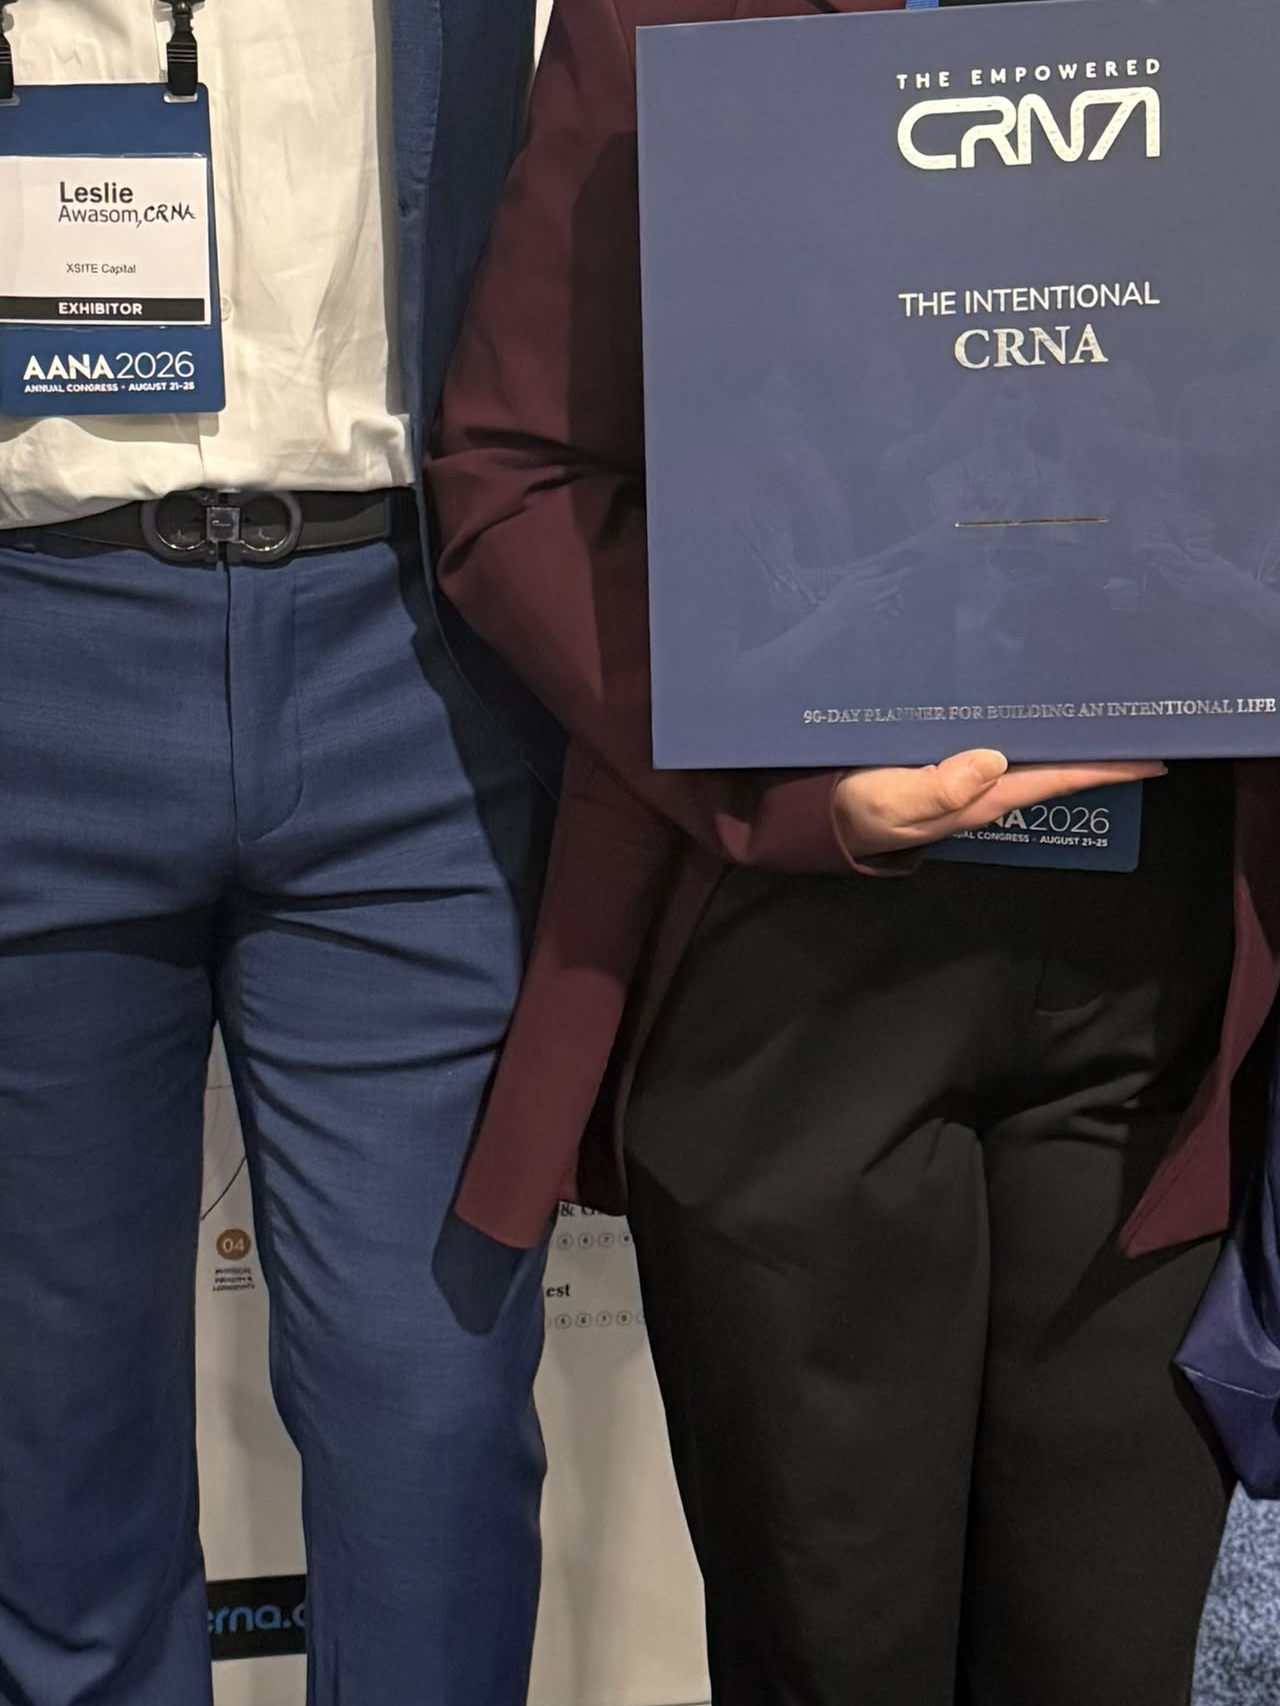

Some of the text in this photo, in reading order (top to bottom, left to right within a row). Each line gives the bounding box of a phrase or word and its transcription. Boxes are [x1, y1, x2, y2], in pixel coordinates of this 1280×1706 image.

[896, 58, 1161, 90] THE EMPOWERED
[897, 86, 1161, 170] CRNA
[59, 181, 133, 204] Leslie
[66, 263, 136, 276] XSITE Capital
[58, 302, 143, 316] EXHIBITOR
[898, 281, 1161, 317] THE INTENTIONAL
[954, 323, 1109, 369] CRNA
[128, 382, 167, 392] AUGUST
[804, 698, 1277, 724] 90-DAY PLANNER FOR BUILDING AN INTENTIONAL LIFE
[984, 804, 1110, 834] A2026
[977, 831, 1029, 842] CONGRESS
[1040, 836, 1080, 846] AUGUST
[223, 1237, 244, 1253] 04
[545, 1283, 570, 1297] est
[208, 1603, 305, 1635] rna.
